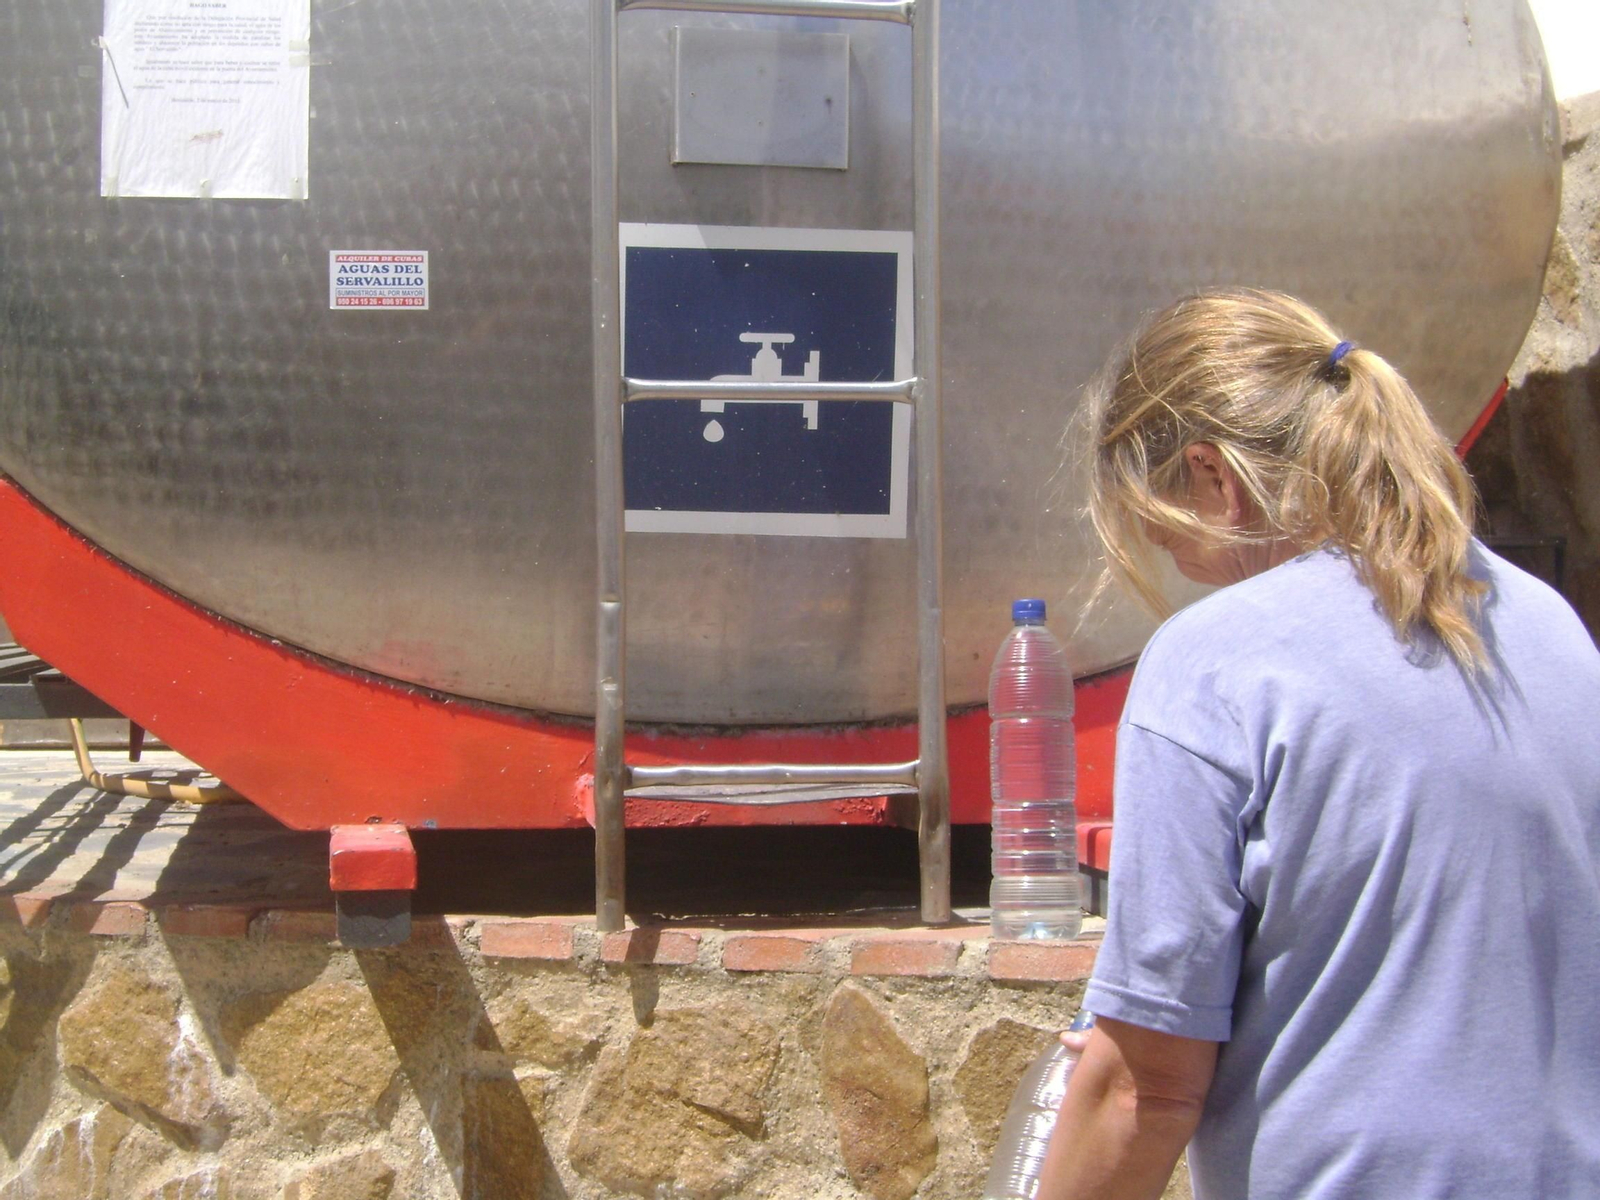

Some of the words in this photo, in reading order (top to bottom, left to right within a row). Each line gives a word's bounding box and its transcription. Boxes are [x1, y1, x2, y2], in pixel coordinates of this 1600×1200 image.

[338, 264, 390, 274] AGUAS
[394, 264, 422, 274] DEL
[336, 277, 424, 286] SERVALILLO
